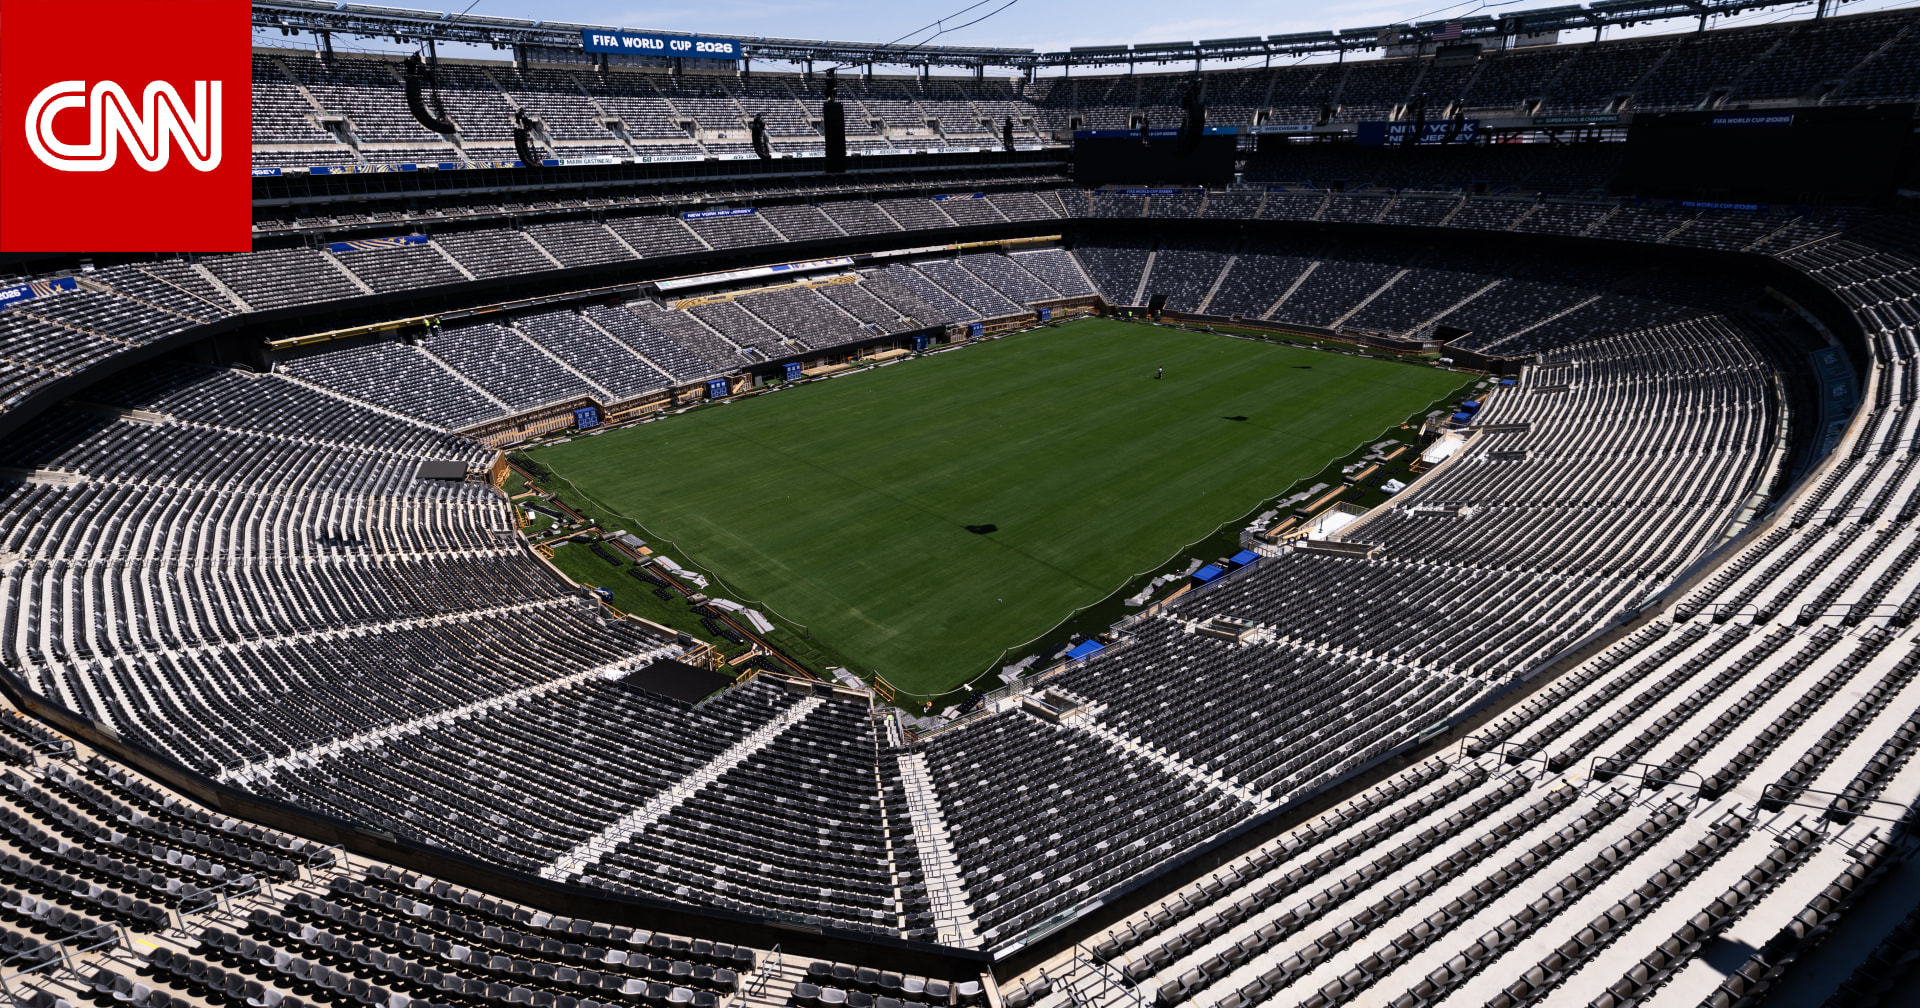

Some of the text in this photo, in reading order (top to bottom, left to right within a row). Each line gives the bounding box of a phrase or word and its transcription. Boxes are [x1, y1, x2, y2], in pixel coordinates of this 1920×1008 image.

[592, 34, 733, 54] FIFA WORLD CUP 2026
[1420, 134, 1473, 142] JEREY
